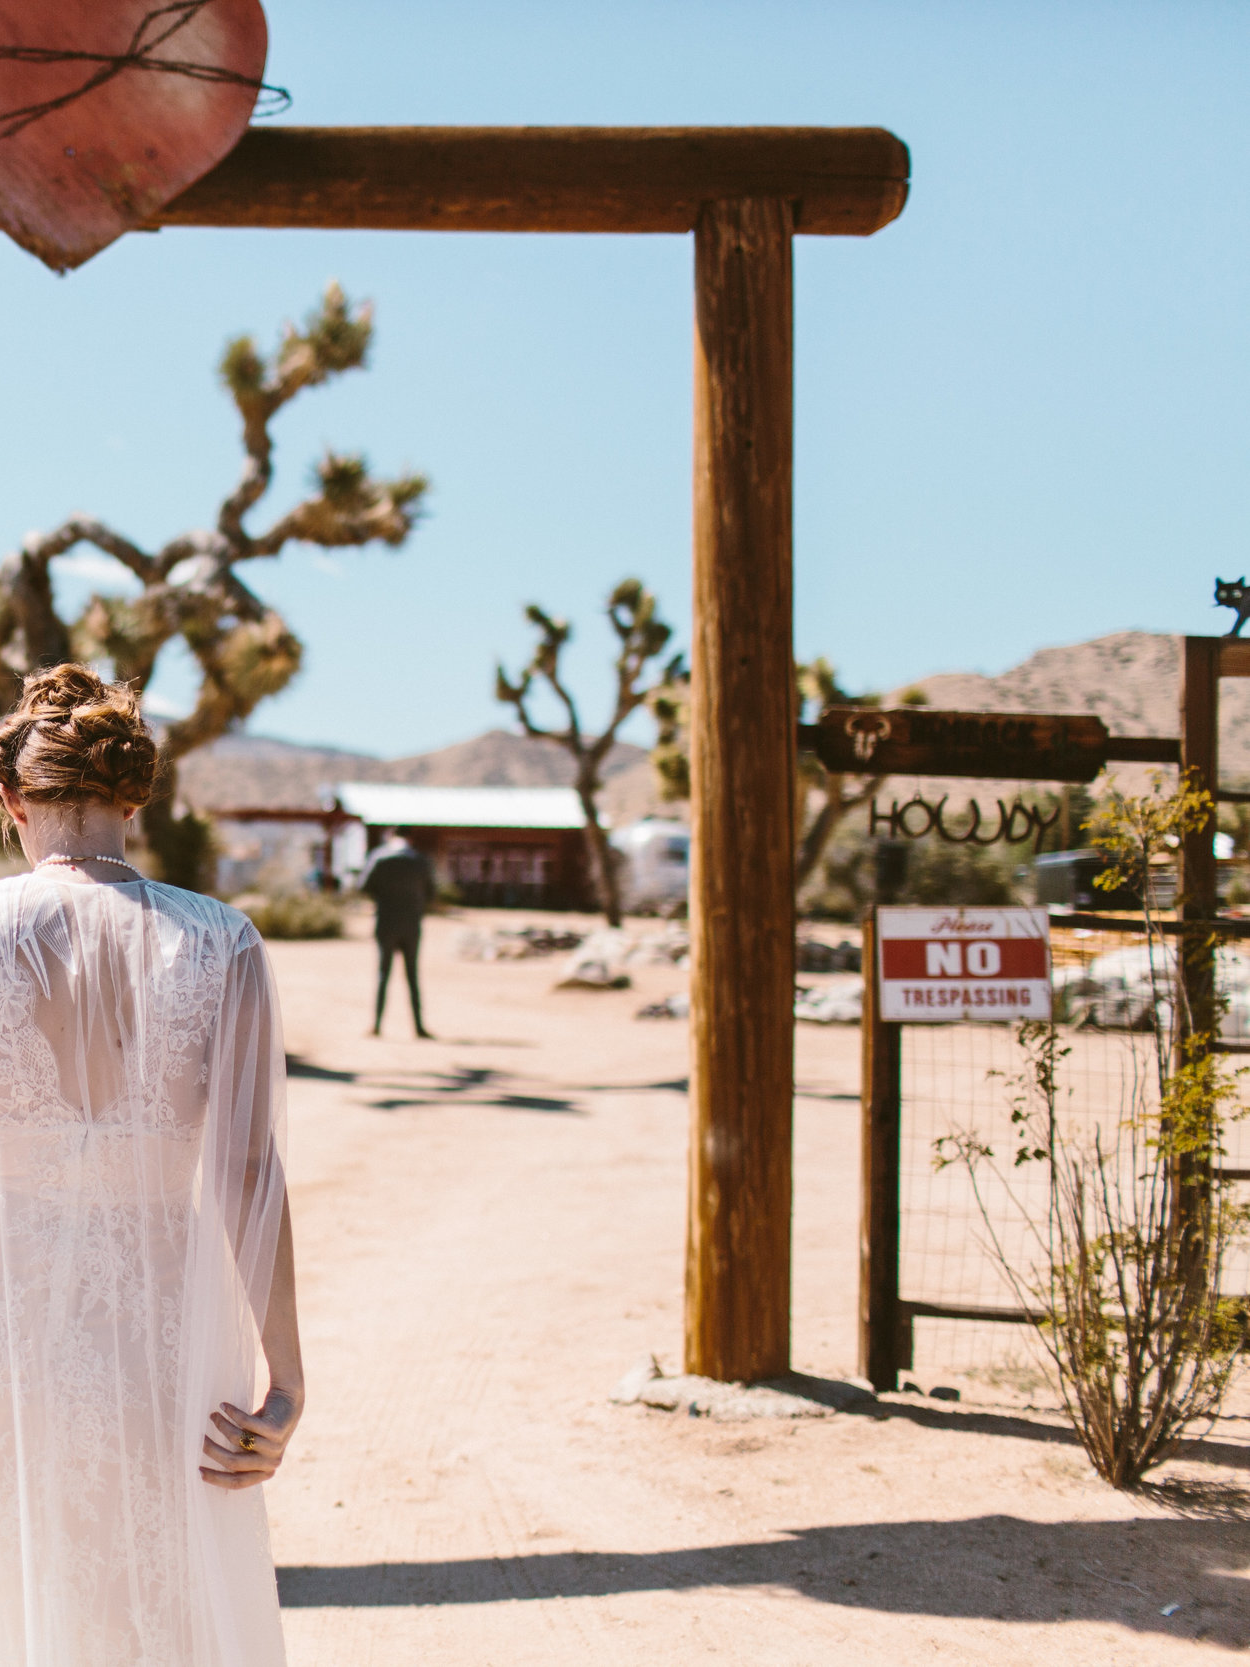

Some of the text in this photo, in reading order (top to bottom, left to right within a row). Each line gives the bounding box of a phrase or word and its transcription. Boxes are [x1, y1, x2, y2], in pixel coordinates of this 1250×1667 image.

[869, 793, 1061, 854] HOWDY
[932, 916, 993, 934] Please
[925, 940, 1001, 977] NO
[902, 986, 1032, 1009] TRESPASSING
